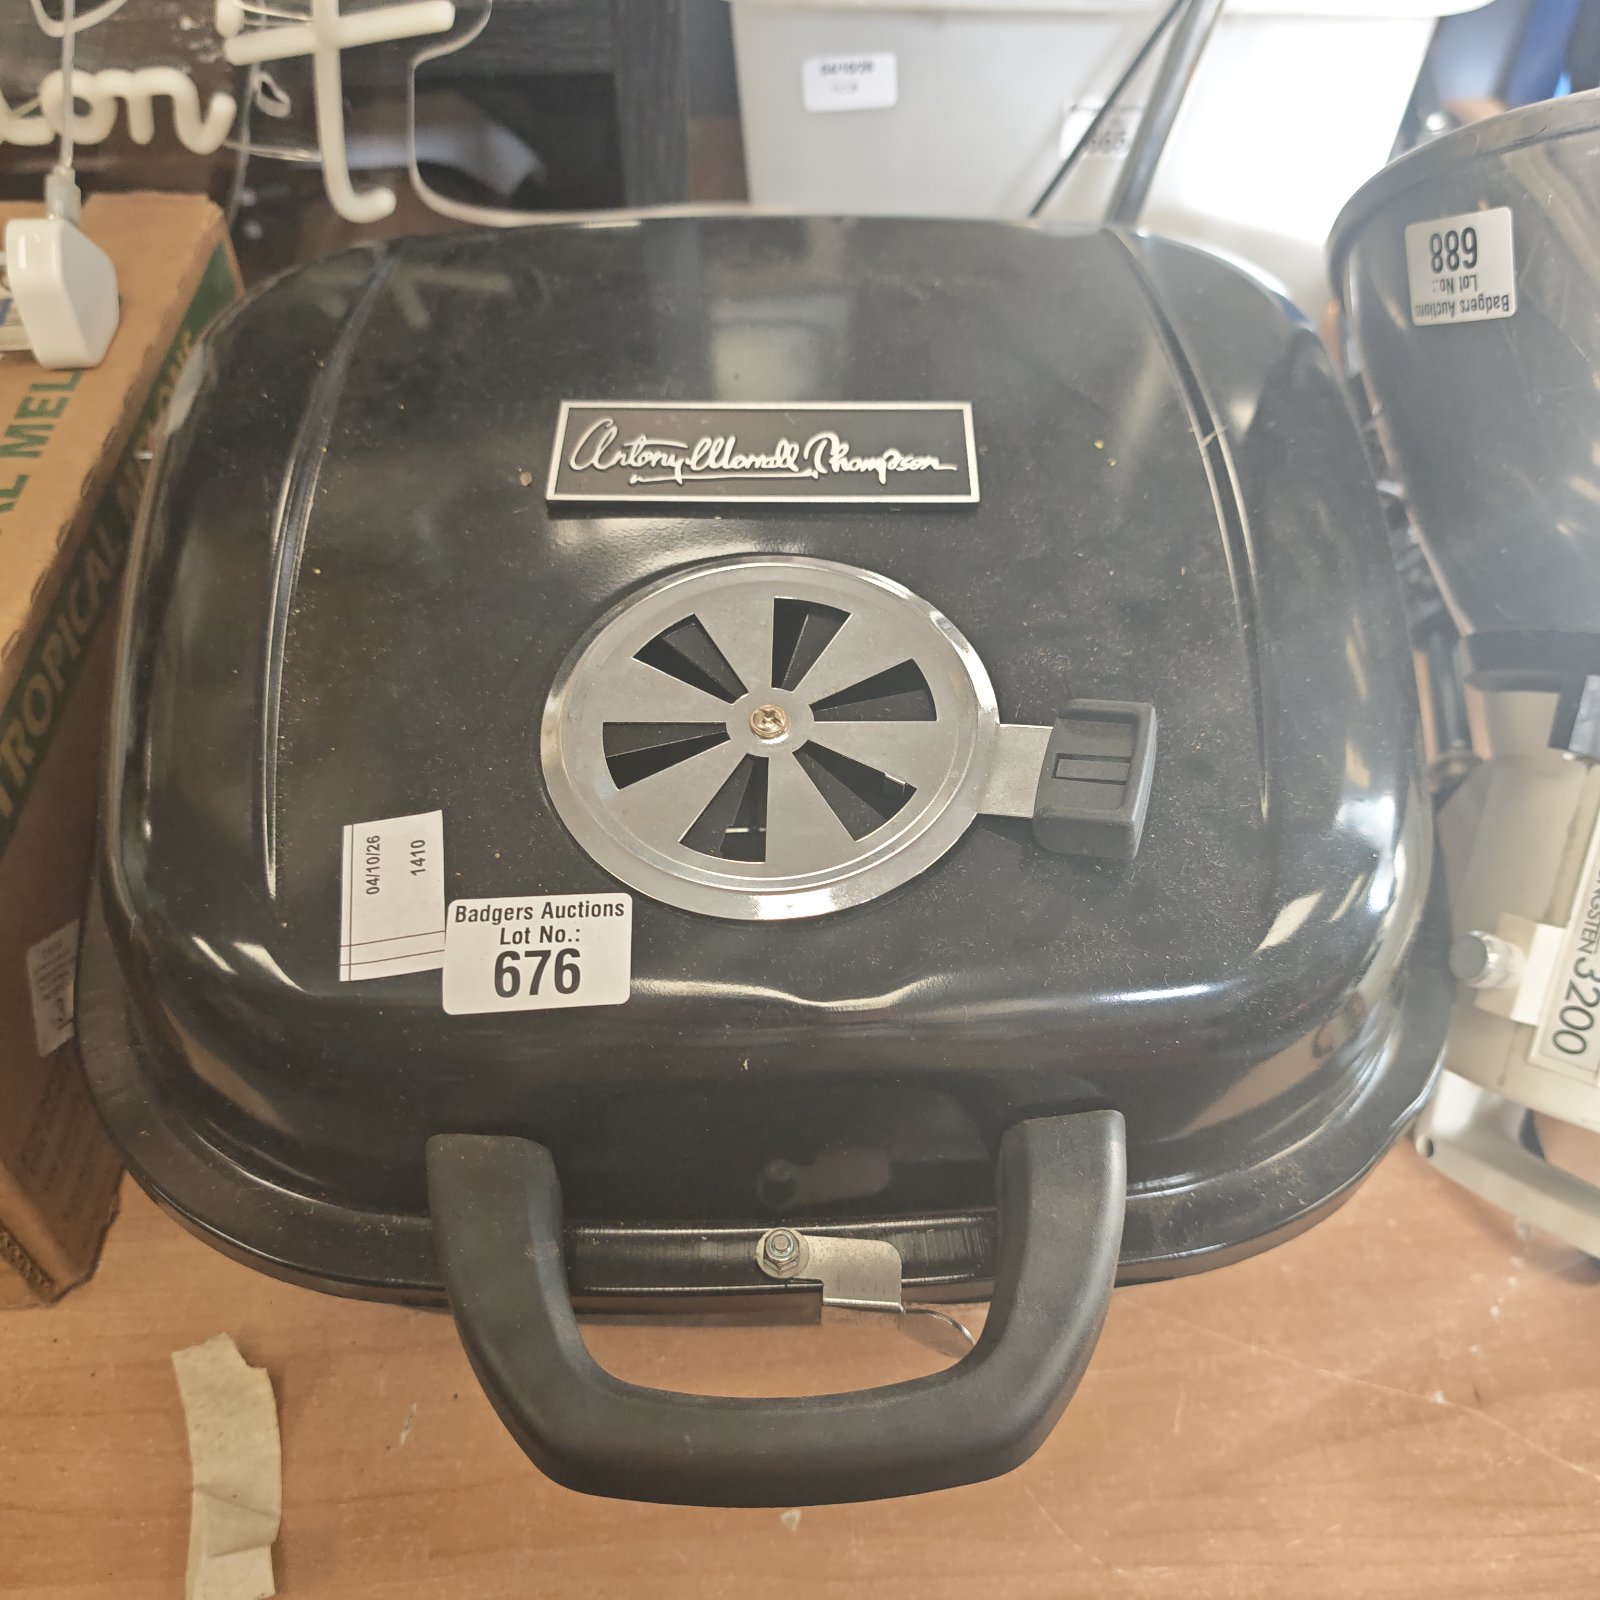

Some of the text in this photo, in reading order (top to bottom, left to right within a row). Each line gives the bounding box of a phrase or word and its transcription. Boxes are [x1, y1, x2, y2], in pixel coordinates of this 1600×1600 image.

[1429, 226, 1478, 274] 688
[1459, 275, 1478, 293] Lot
[1460, 293, 1510, 314] Badgers
[0, 368, 83, 458] MEL
[804, 430, 958, 485] Thompson
[0, 526, 123, 817] ROPICAL
[365, 834, 381, 896] 04/10/26
[409, 838, 426, 878] 1410
[454, 900, 625, 926] Badgers Auctions
[499, 925, 582, 946] Lot No.:
[493, 947, 582, 999] 676
